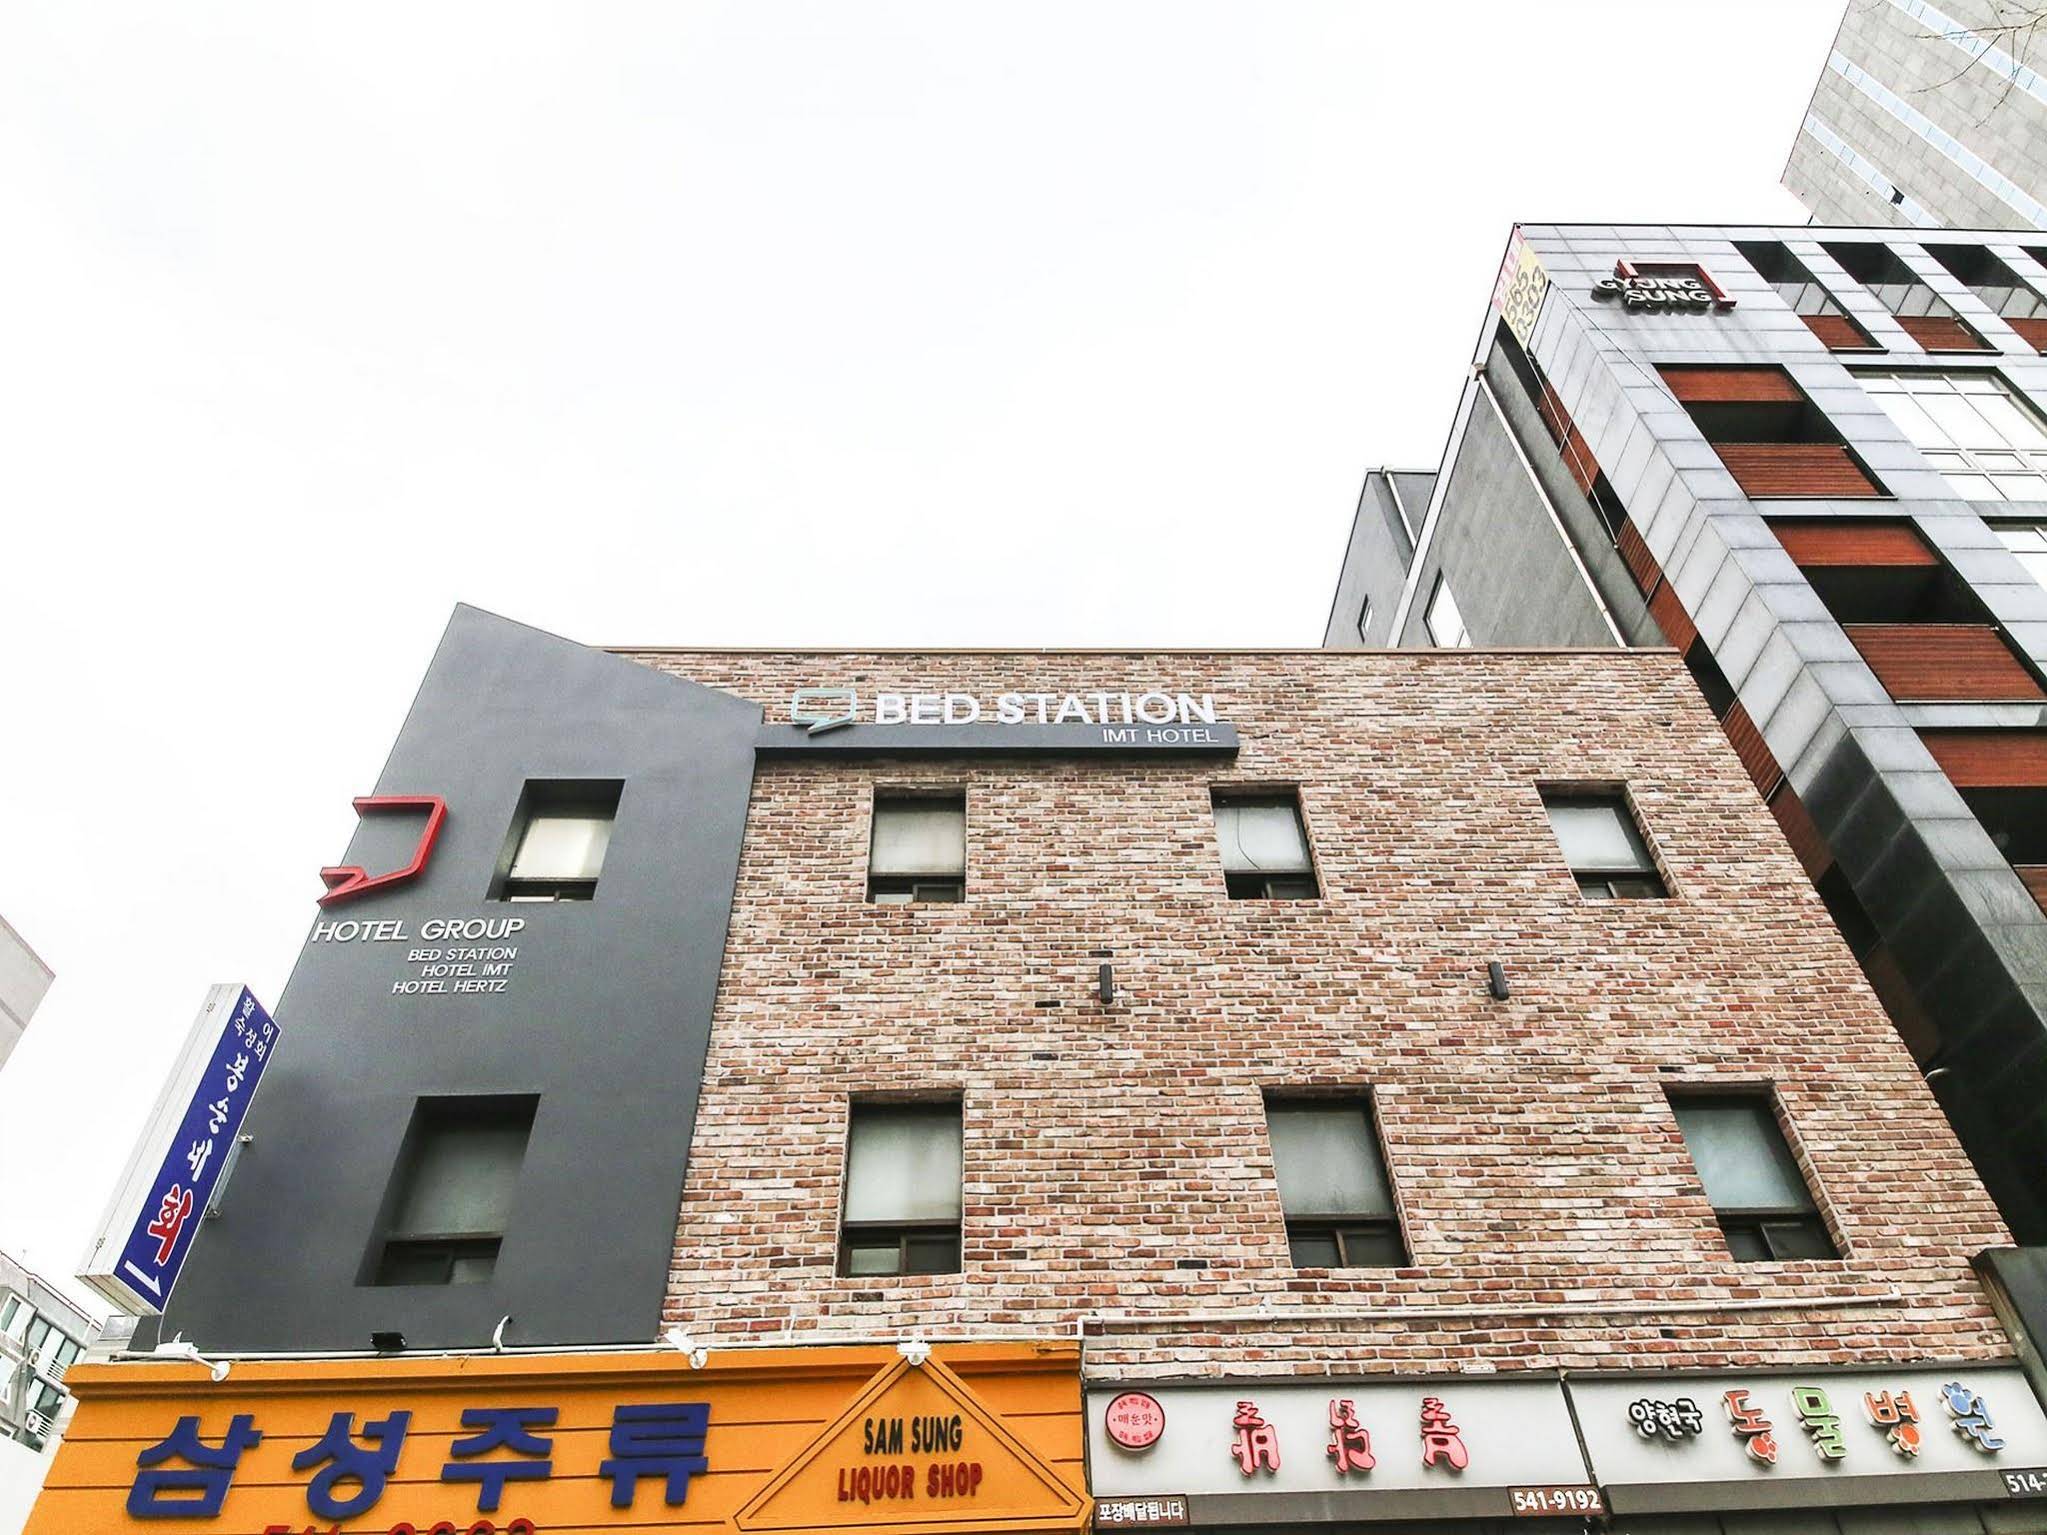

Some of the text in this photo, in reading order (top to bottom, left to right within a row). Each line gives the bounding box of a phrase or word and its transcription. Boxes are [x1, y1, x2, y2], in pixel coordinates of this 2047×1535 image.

[1505, 264, 1529, 324] 565
[1625, 289, 1712, 304] SUNG
[875, 691, 1219, 725] BED STATION
[1102, 727, 1219, 743] IMT HOTEL
[311, 917, 525, 943] HOTEL GROUP
[407, 946, 518, 962] BED STATION
[421, 962, 513, 977] HOTEL IMT
[391, 978, 508, 994] HOTEL HERTZ
[1117, 1413, 1153, 1426] 매운맛
[1628, 1382, 2008, 1465] 양현국 동물병원
[863, 1413, 963, 1454] SAM SUNG
[126, 1402, 711, 1519] 삼성주류
[837, 1463, 983, 1503] LIQUOR SHOP
[2005, 1472, 2047, 1493] 514-
[1098, 1500, 1184, 1522] 포장배달됩니다
[1512, 1486, 1602, 1513] 541-9192
